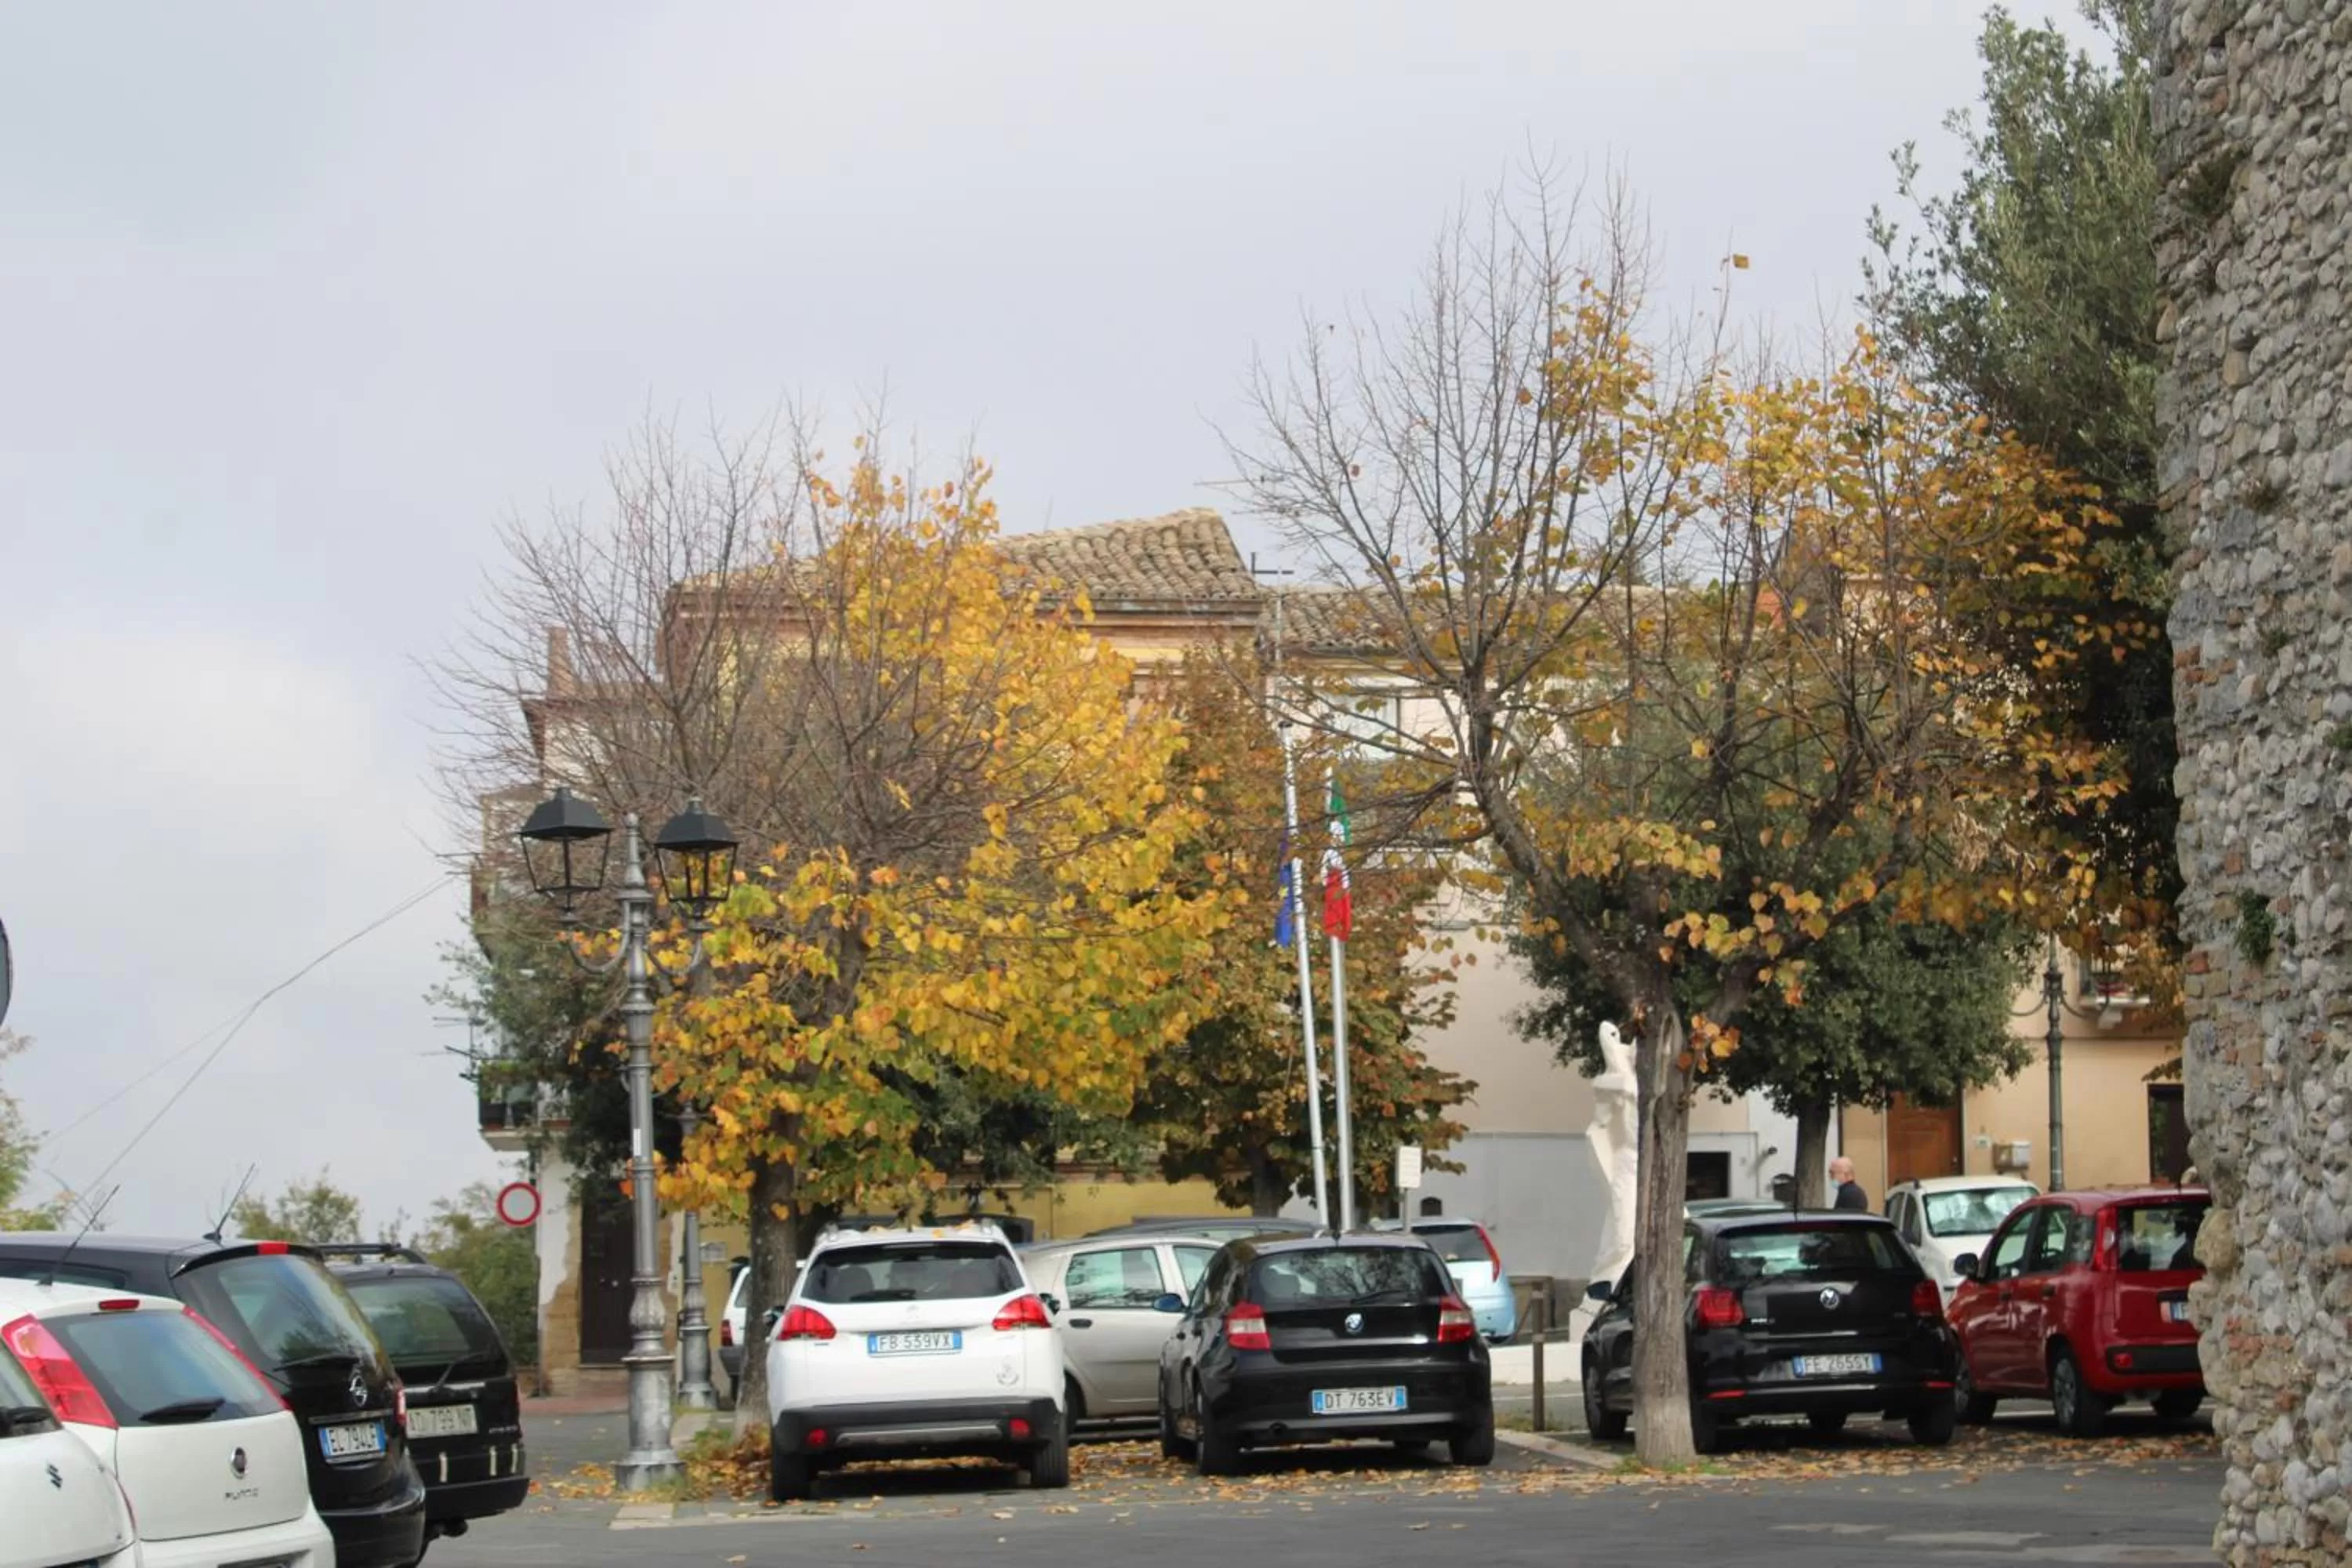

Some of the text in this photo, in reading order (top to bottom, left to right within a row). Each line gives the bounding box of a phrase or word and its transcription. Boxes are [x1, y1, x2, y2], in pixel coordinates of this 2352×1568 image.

[879, 1335, 898, 1350] FB
[1325, 1392, 1393, 1409] DT 763EV
